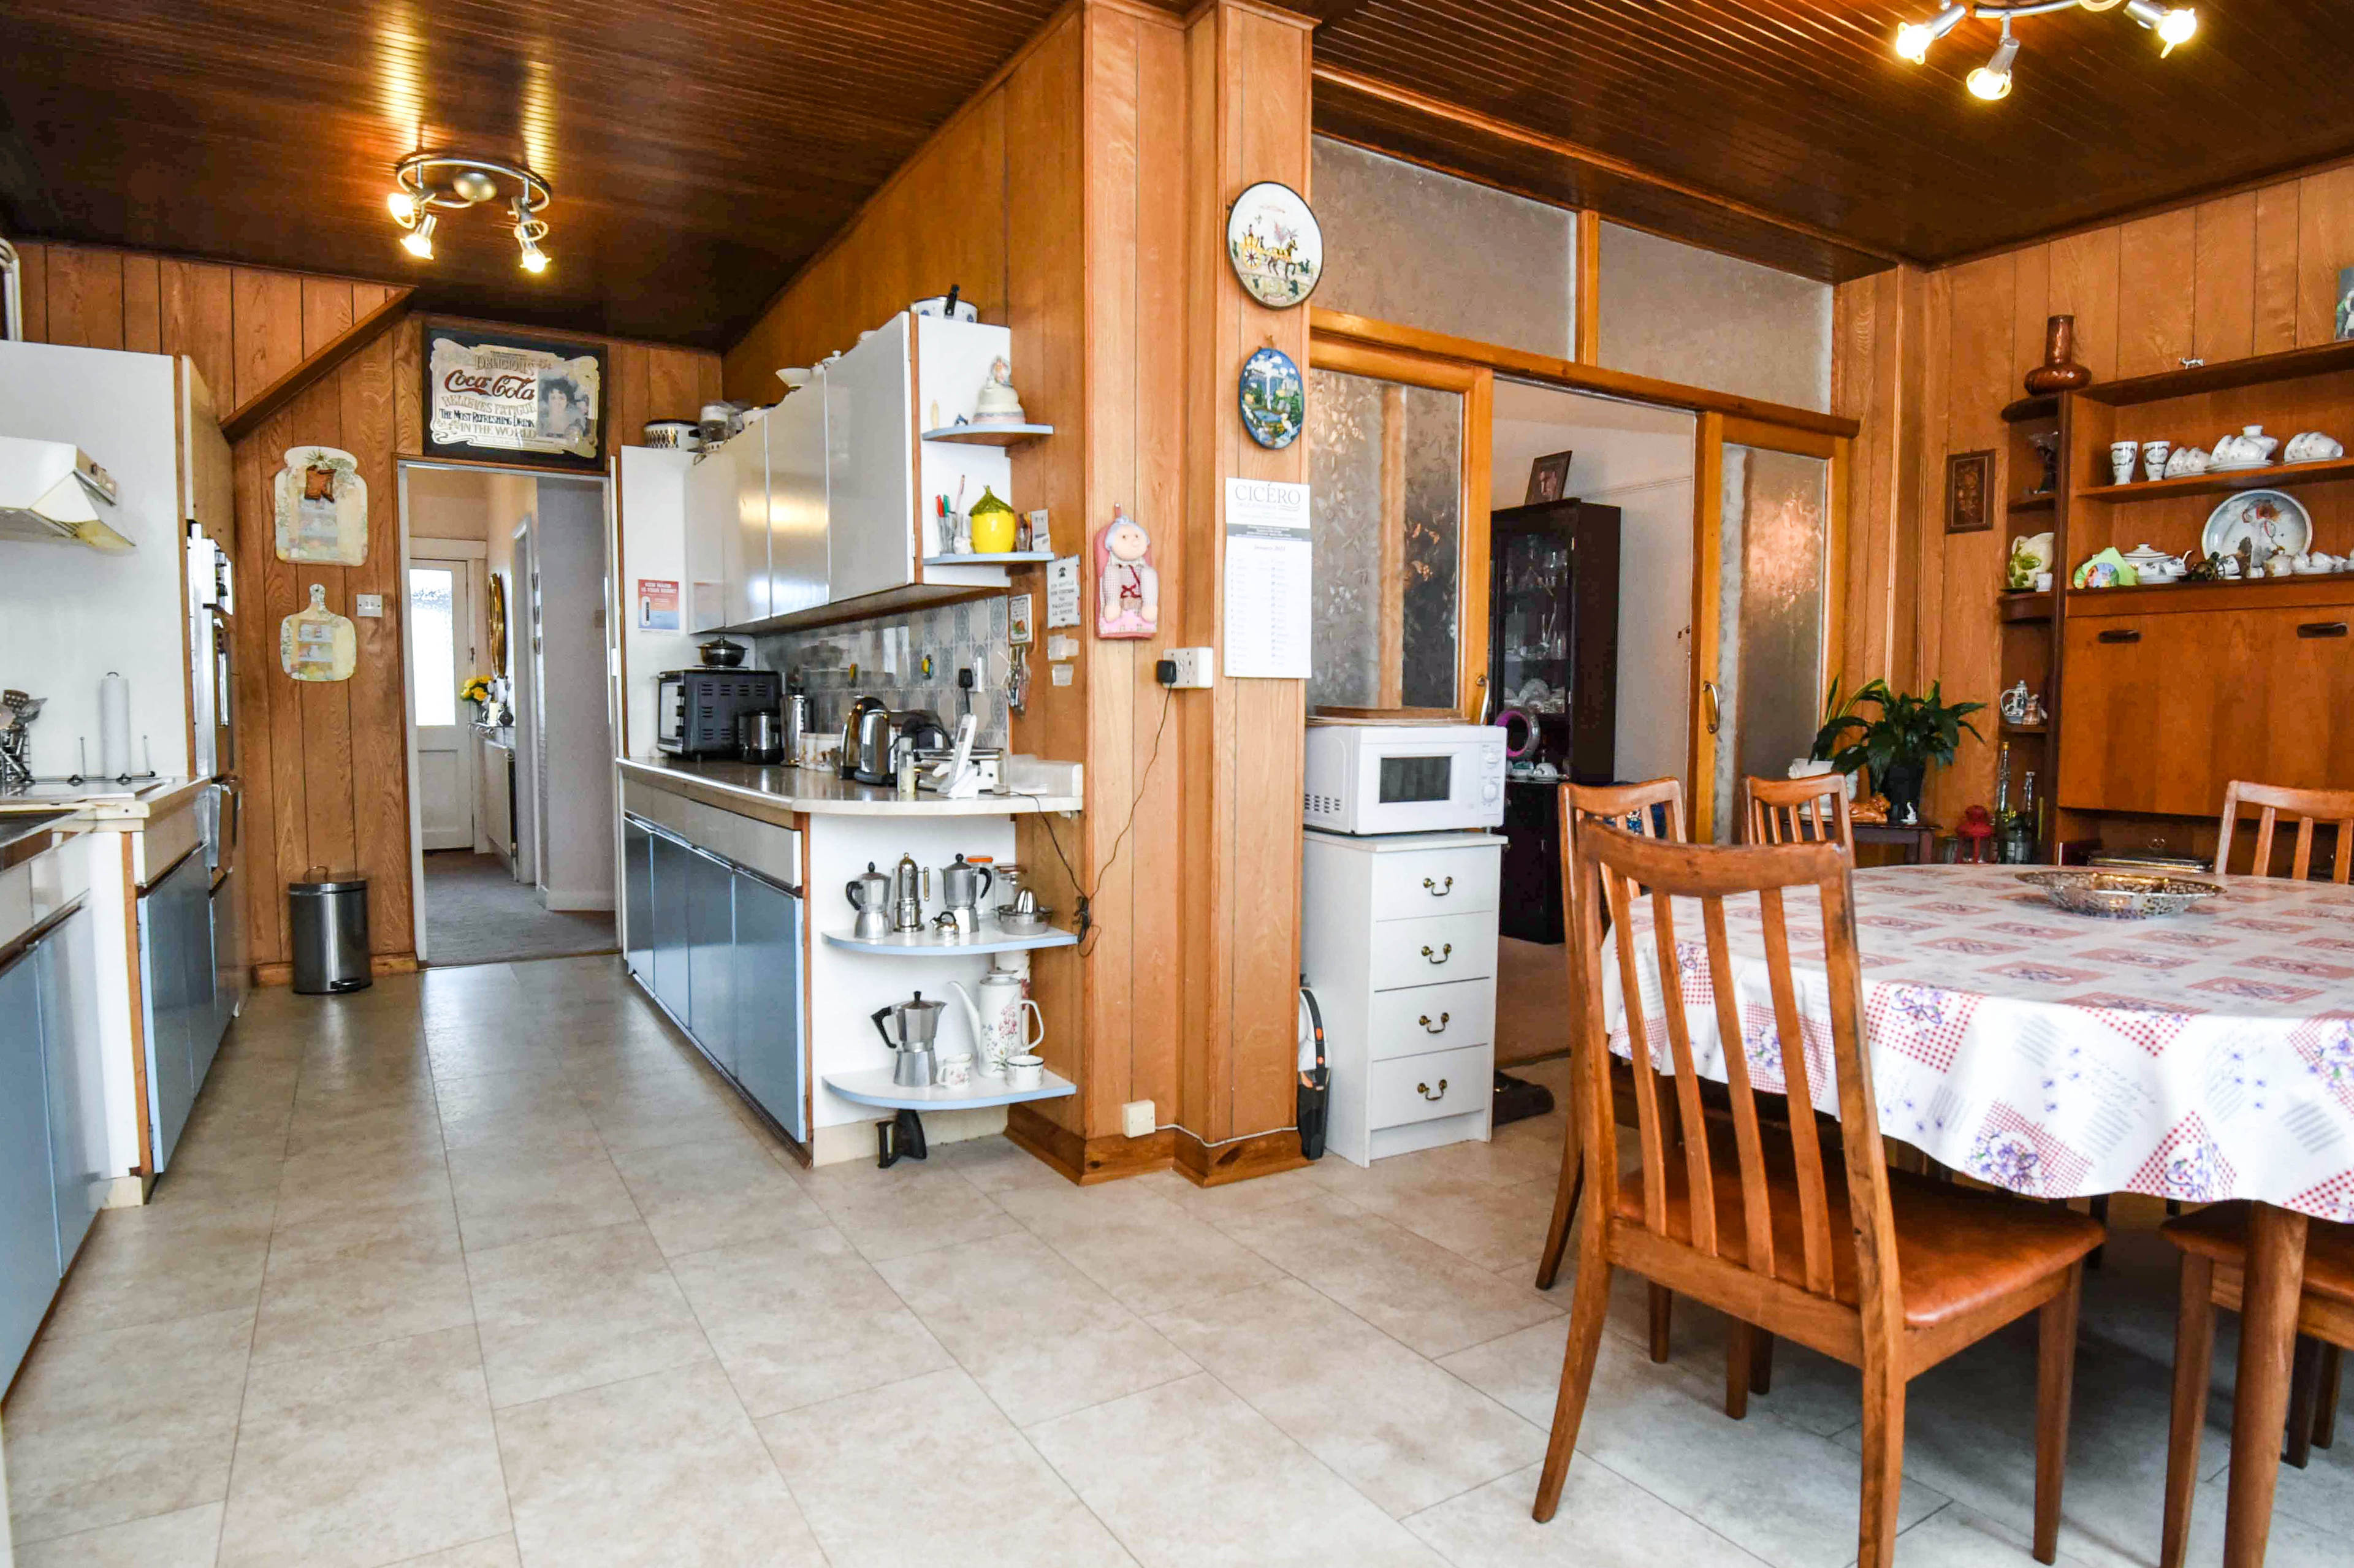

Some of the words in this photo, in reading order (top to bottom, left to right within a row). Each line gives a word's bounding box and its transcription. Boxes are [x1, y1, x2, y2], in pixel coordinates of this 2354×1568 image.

[441, 395, 493, 413] RELIEVES
[495, 402, 536, 416] FATIGUE
[439, 408, 452, 419] THE
[454, 409, 471, 422] MOST
[473, 412, 512, 425] REFRESHING
[513, 415, 535, 428] DRINK
[460, 423, 471, 432] IN
[473, 424, 493, 435] THE
[495, 426, 537, 439] WORLD
[1235, 484, 1301, 506] CICERO
